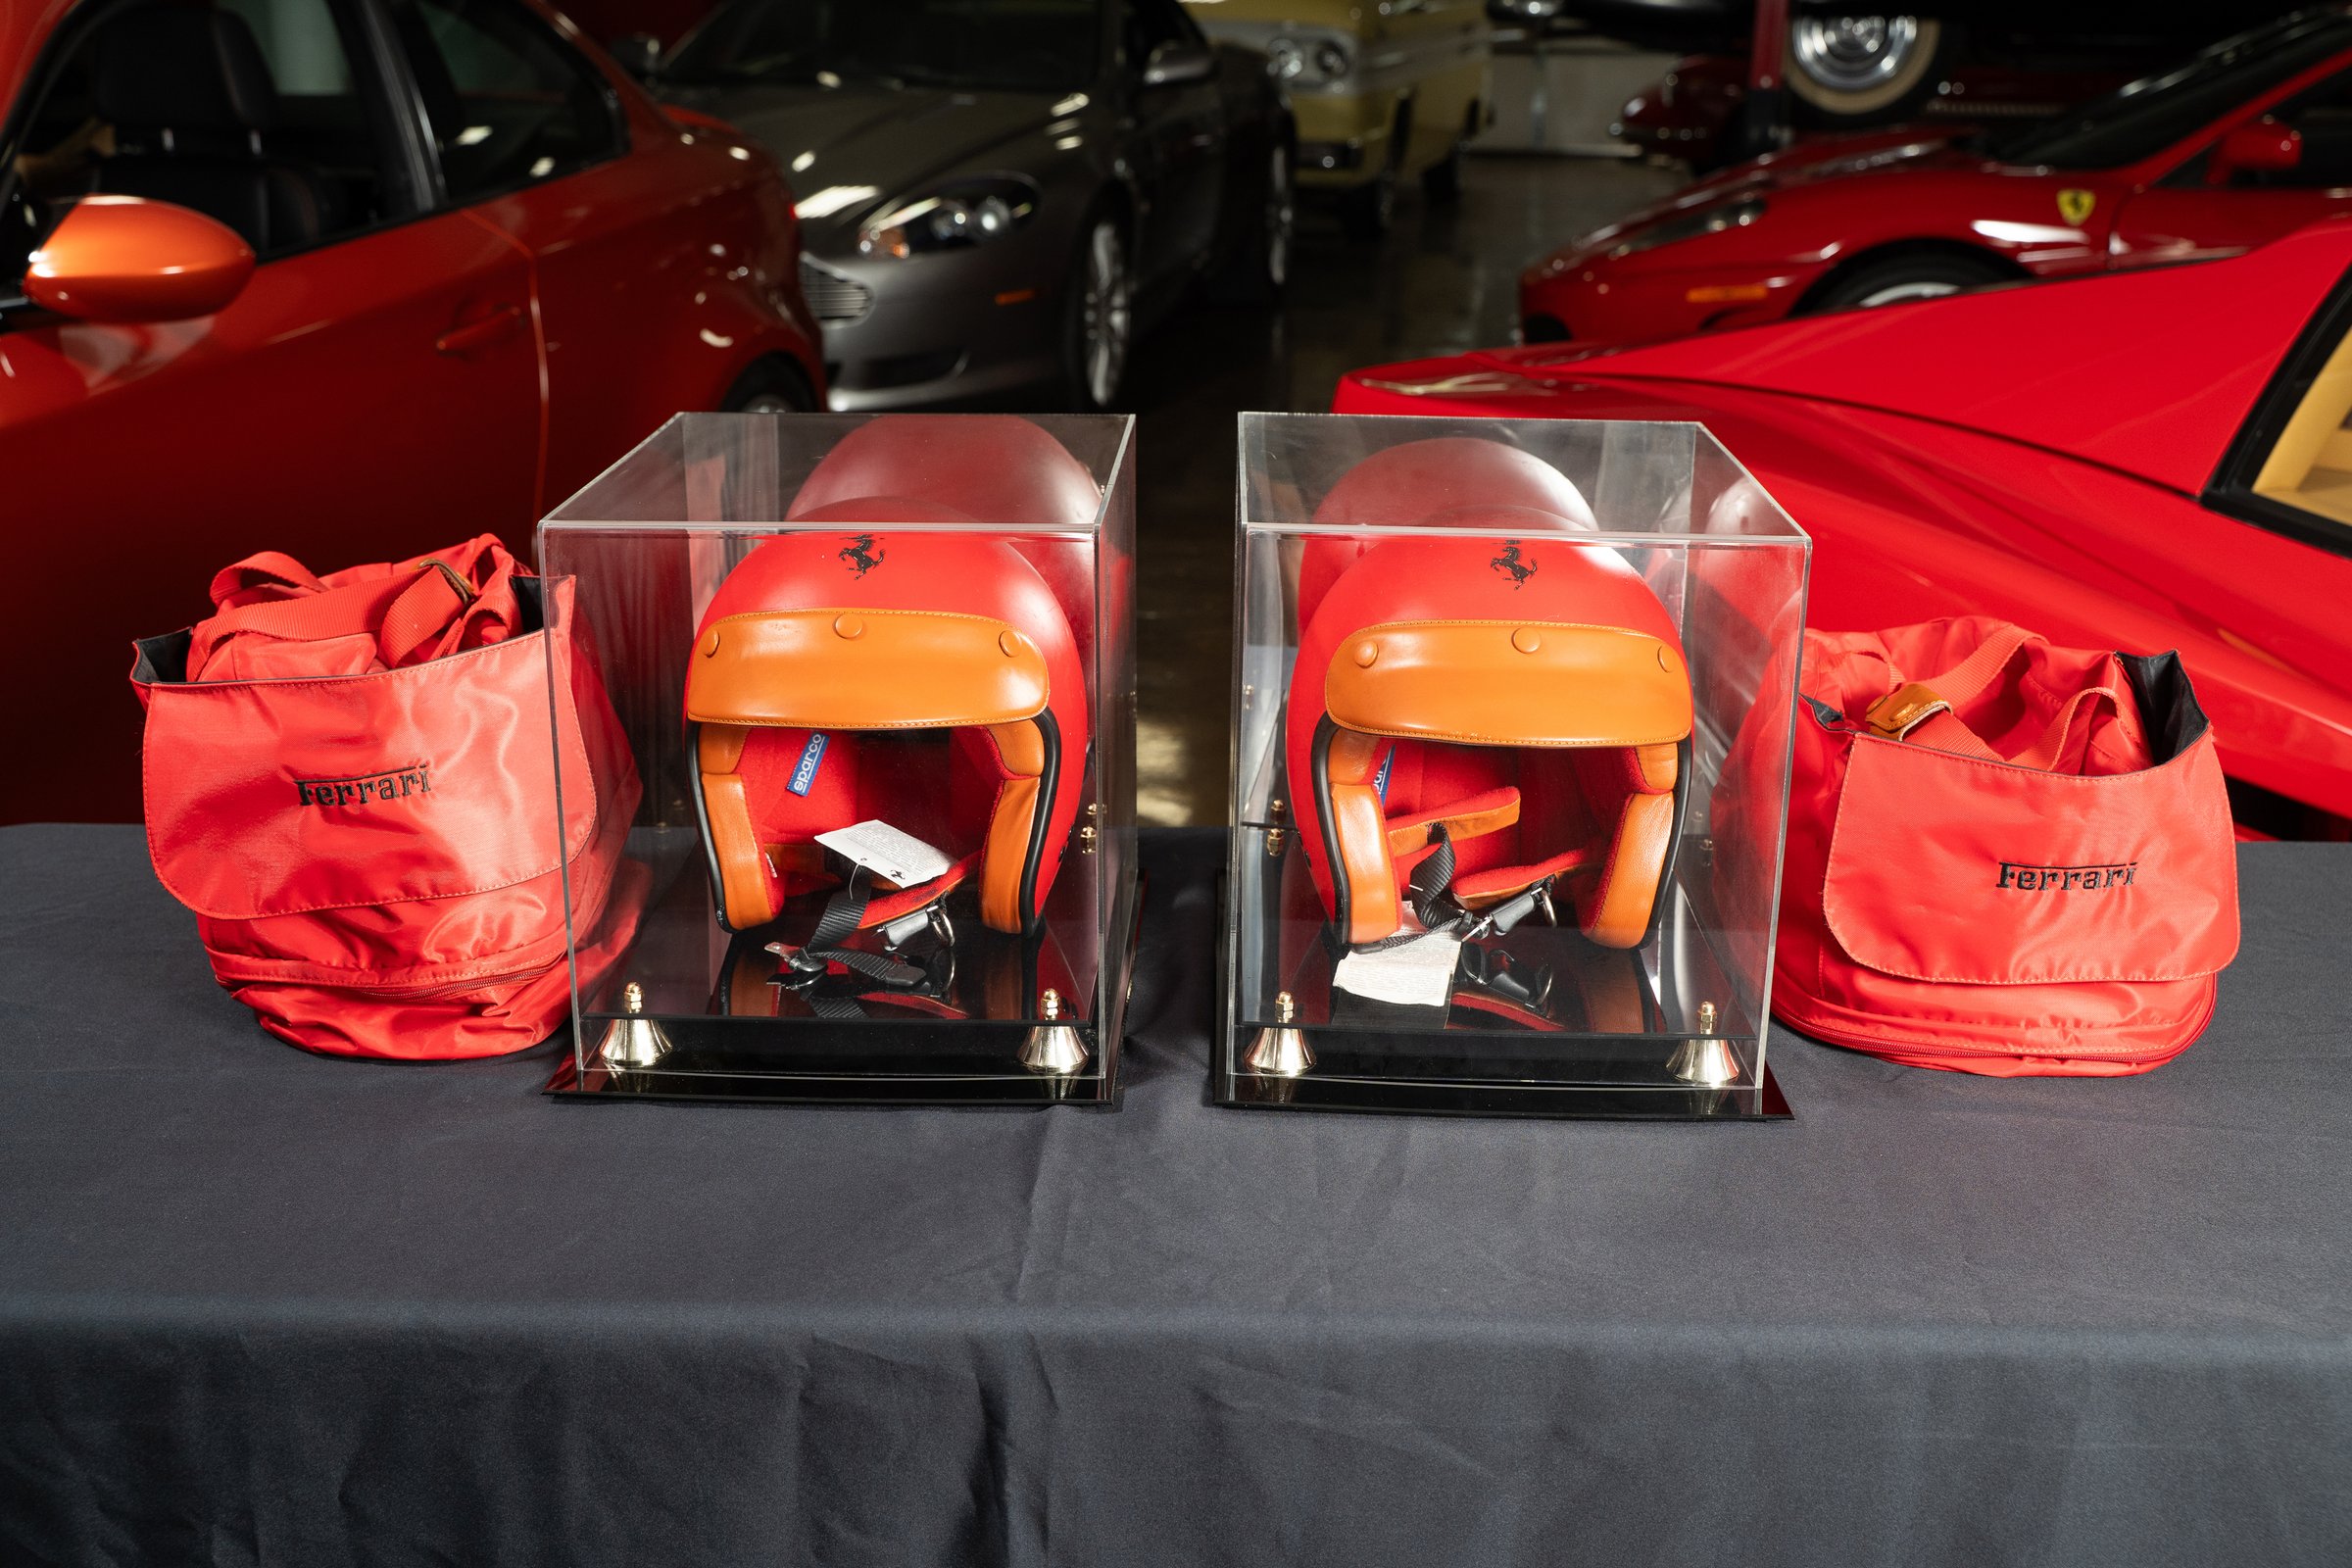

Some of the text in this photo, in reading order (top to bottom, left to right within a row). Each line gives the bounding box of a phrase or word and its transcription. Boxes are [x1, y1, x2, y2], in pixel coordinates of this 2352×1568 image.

[794, 734, 823, 793] sparco
[294, 764, 431, 807] Ferrari
[1996, 861, 2137, 891] Ferrari
